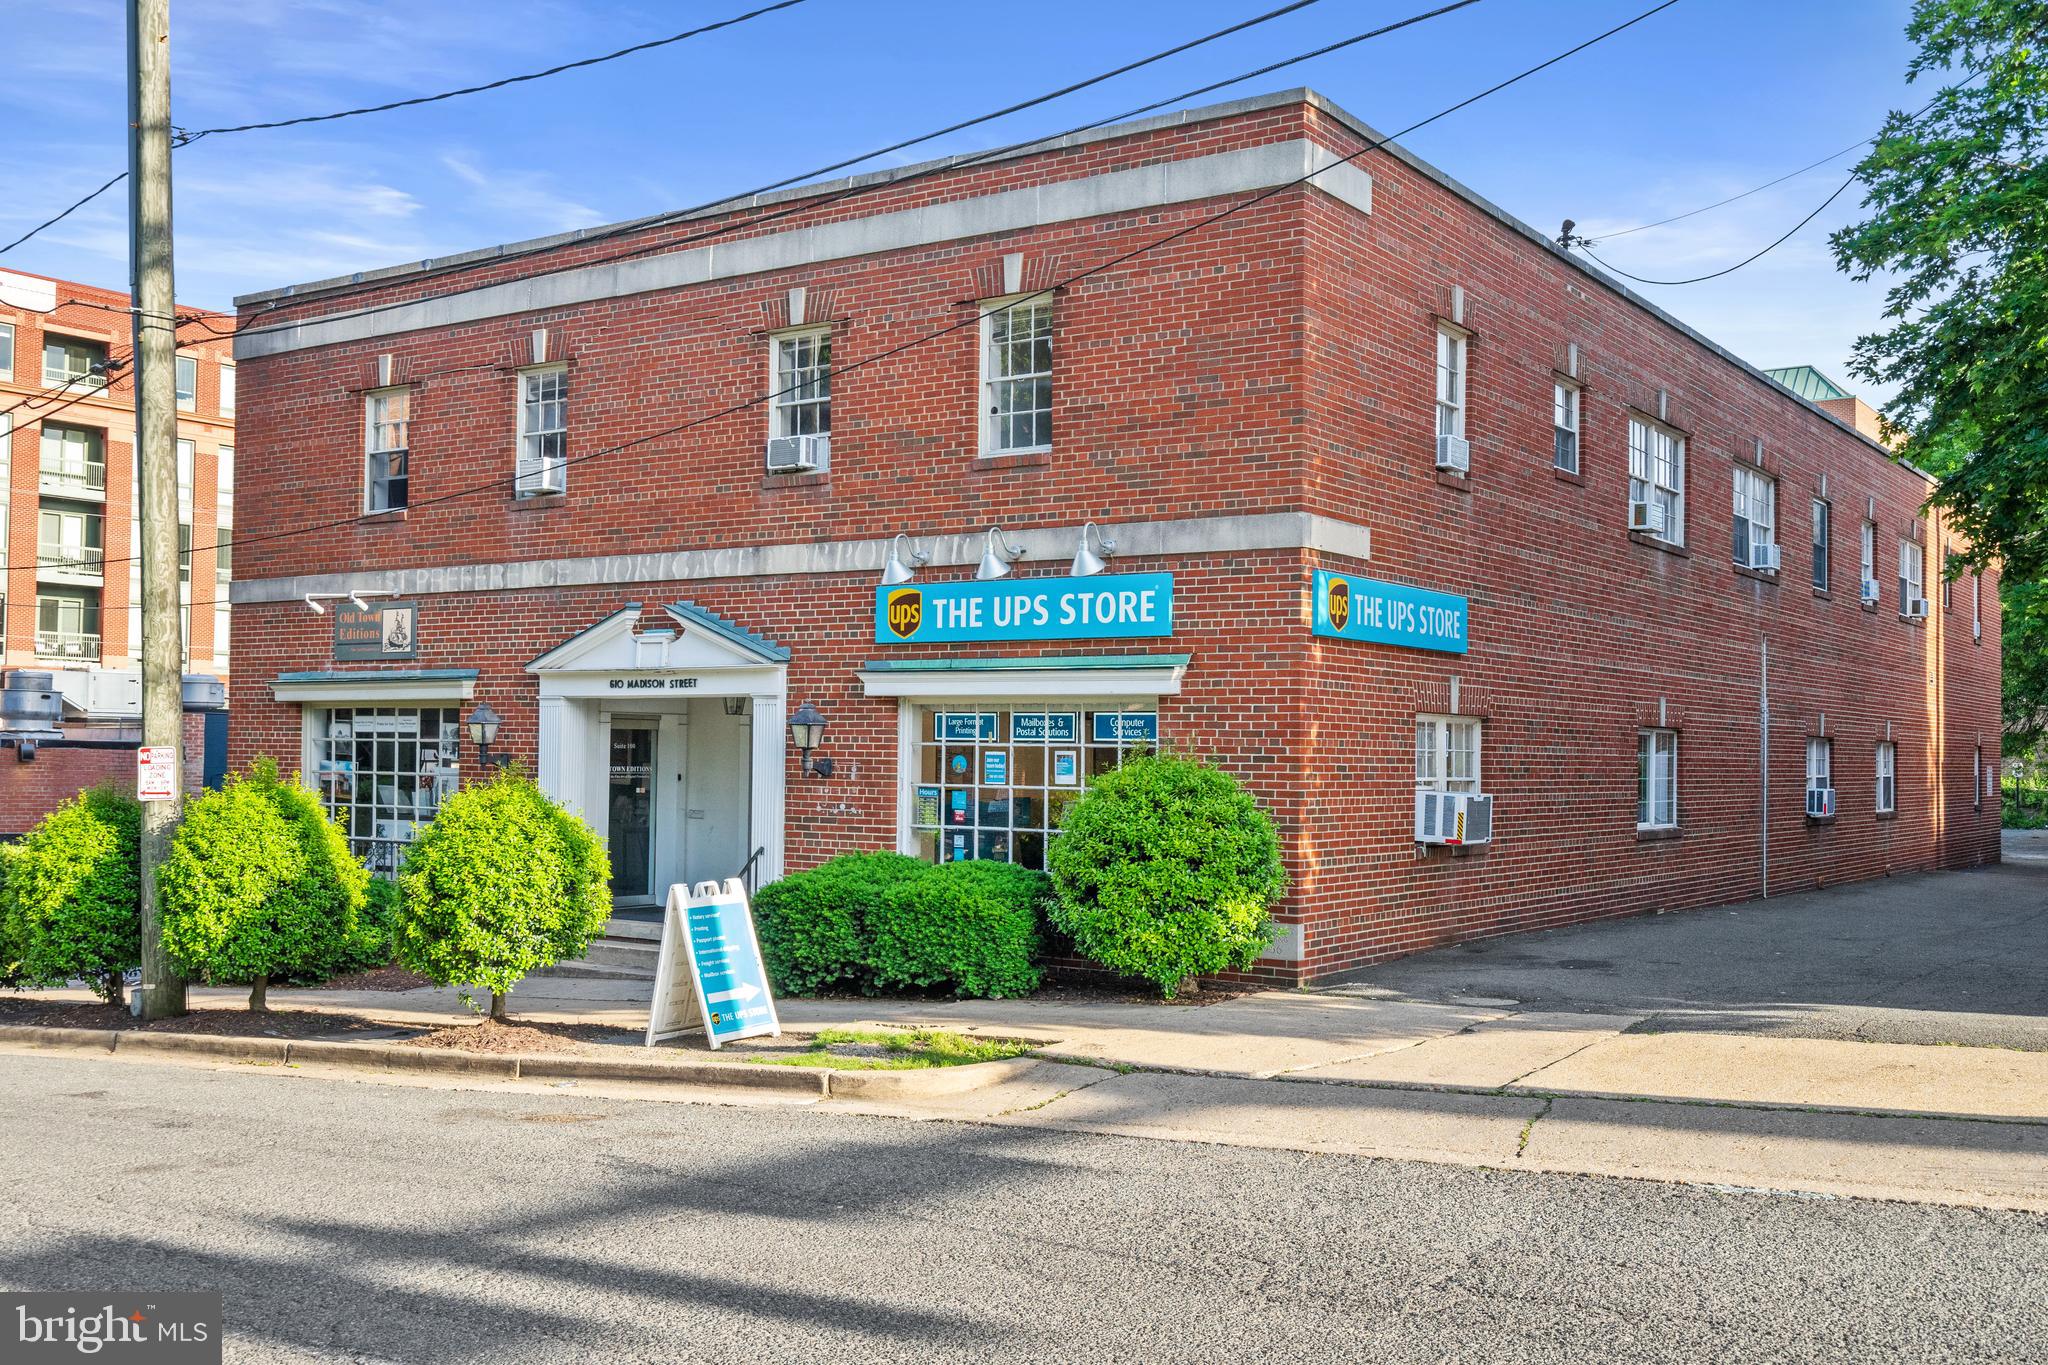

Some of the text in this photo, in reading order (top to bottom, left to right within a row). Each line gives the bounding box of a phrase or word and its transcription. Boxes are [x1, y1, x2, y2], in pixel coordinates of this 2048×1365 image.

[933, 590, 1156, 628] THE UPS STORE
[1330, 594, 1348, 623] ups
[339, 611, 382, 624] Old Town
[890, 603, 920, 631] ups
[1355, 594, 1461, 639] THE UPS STORE
[339, 628, 380, 640] Editions
[609, 678, 698, 689] 610 MADISON STREET
[948, 717, 963, 727] Large
[1021, 717, 1064, 727] Mailboes &
[1016, 727, 1069, 737] Postal Soutions
[1112, 726, 1142, 736] Srvices
[141, 752, 151, 761] NO
[919, 788, 938, 796] Hours
[721, 1012, 735, 1022] THE
